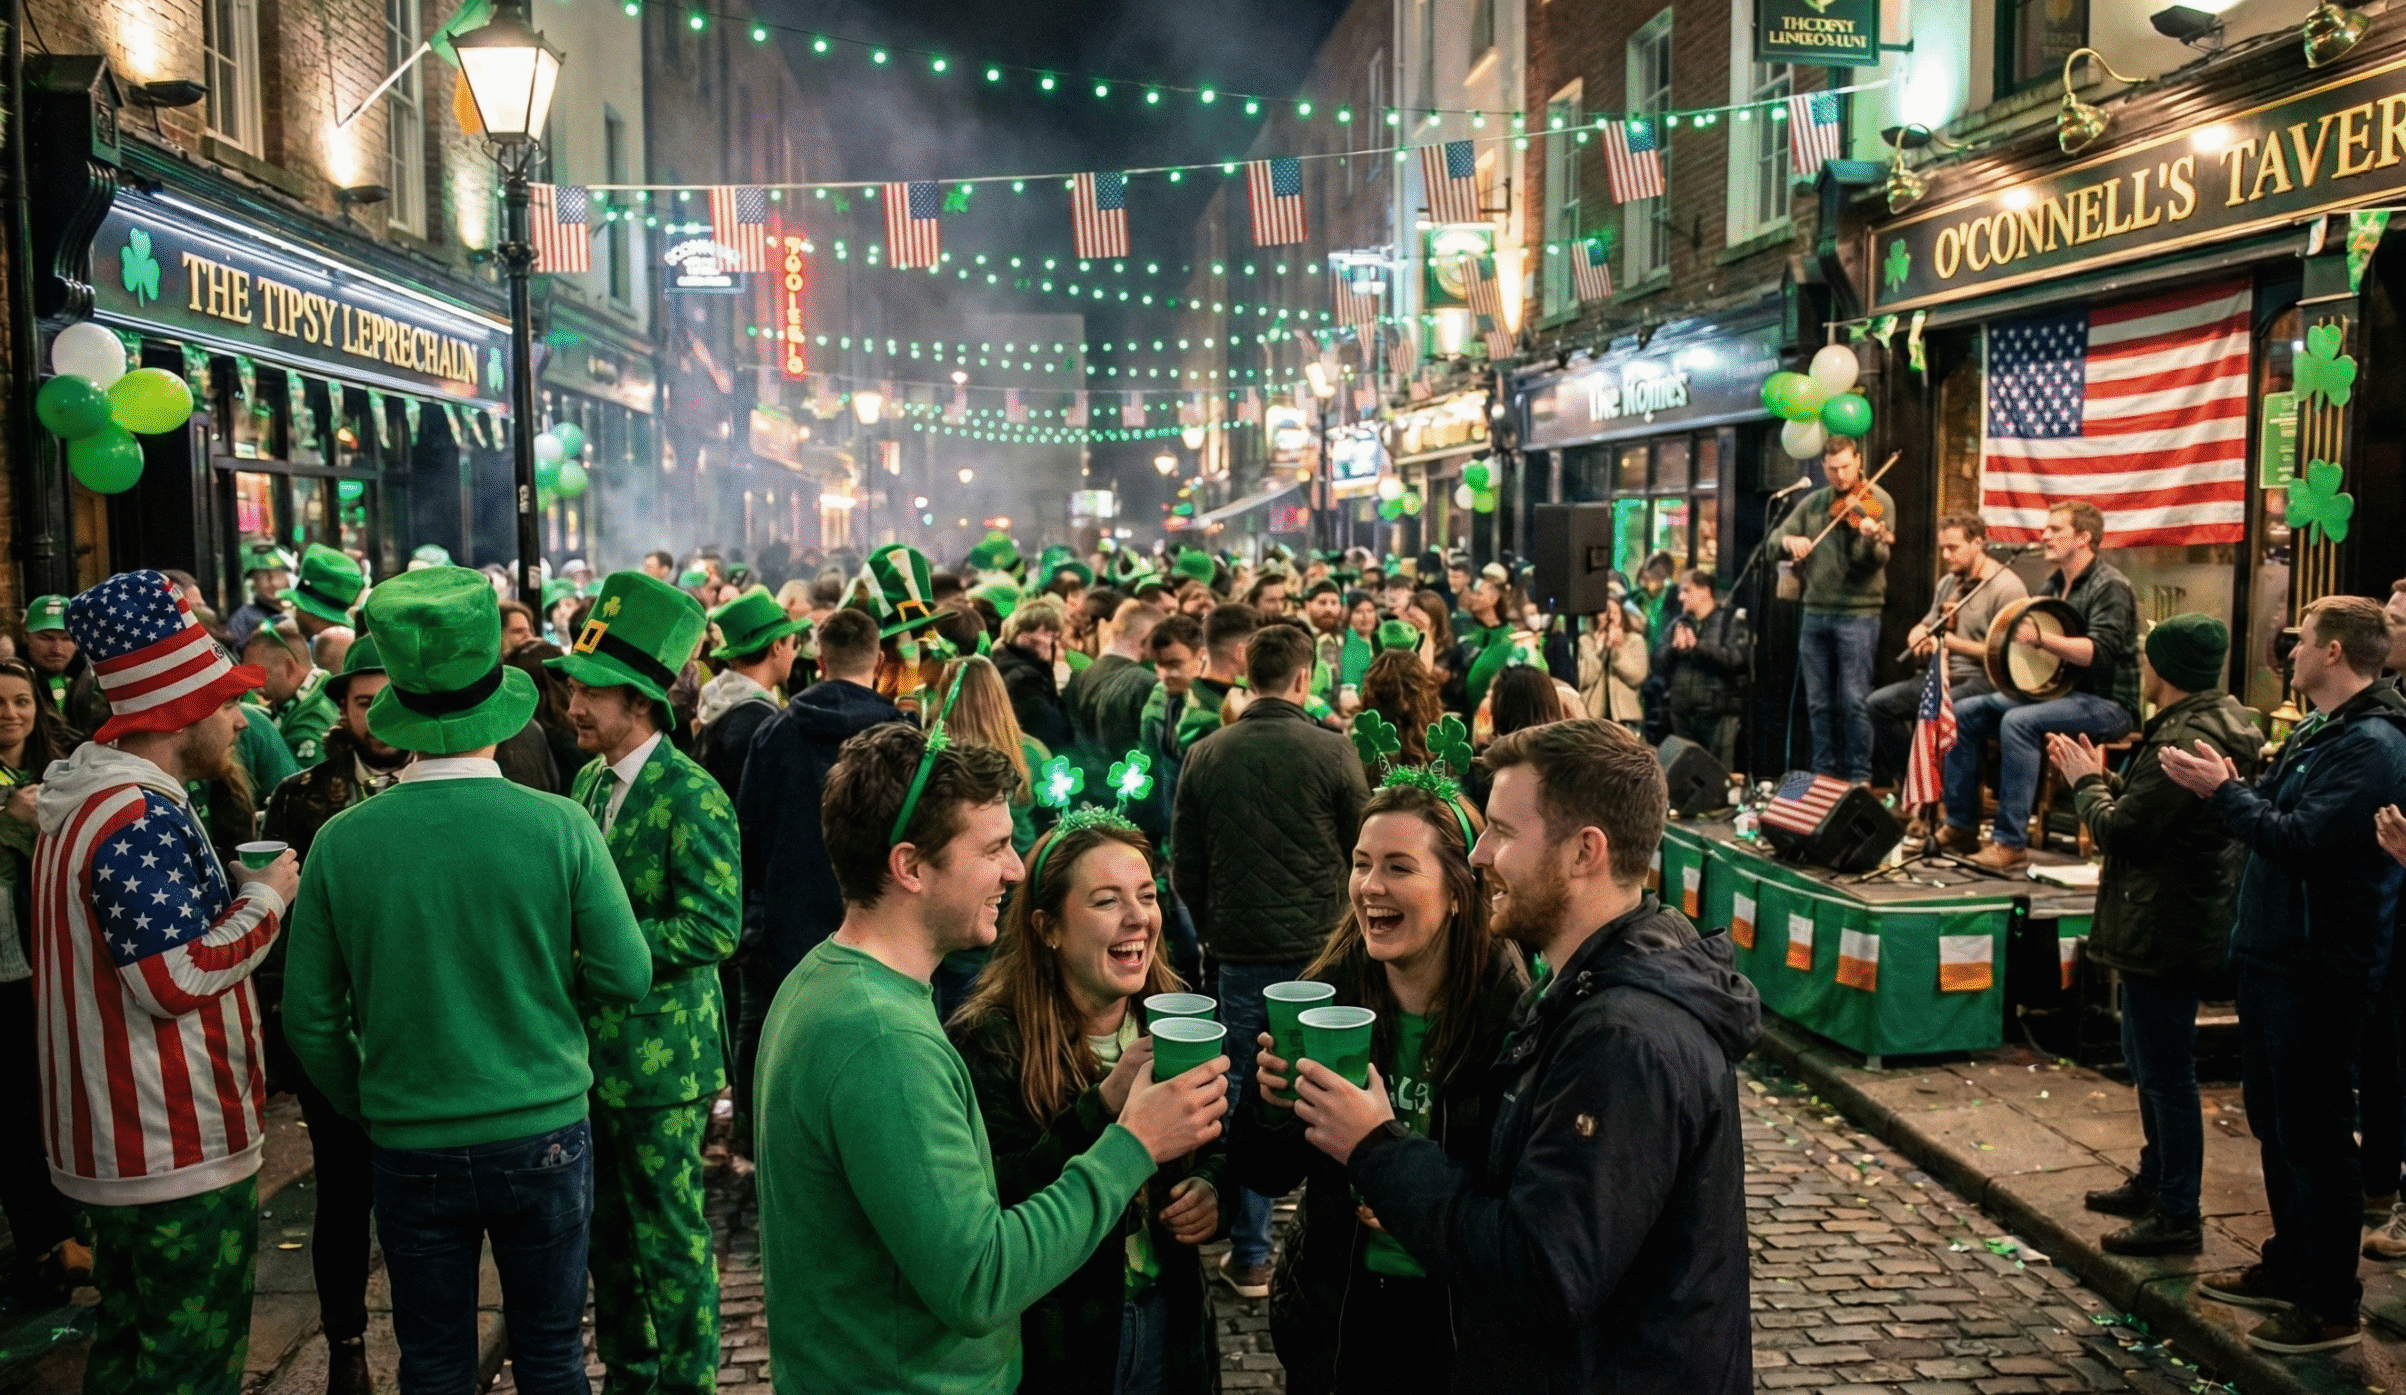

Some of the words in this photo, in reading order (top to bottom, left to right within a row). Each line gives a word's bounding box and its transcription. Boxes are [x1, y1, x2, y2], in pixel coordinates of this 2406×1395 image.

[1933, 155, 2197, 281] O'CONNELL'S
[182, 251, 252, 324] THE
[257, 275, 338, 347] TIPSY
